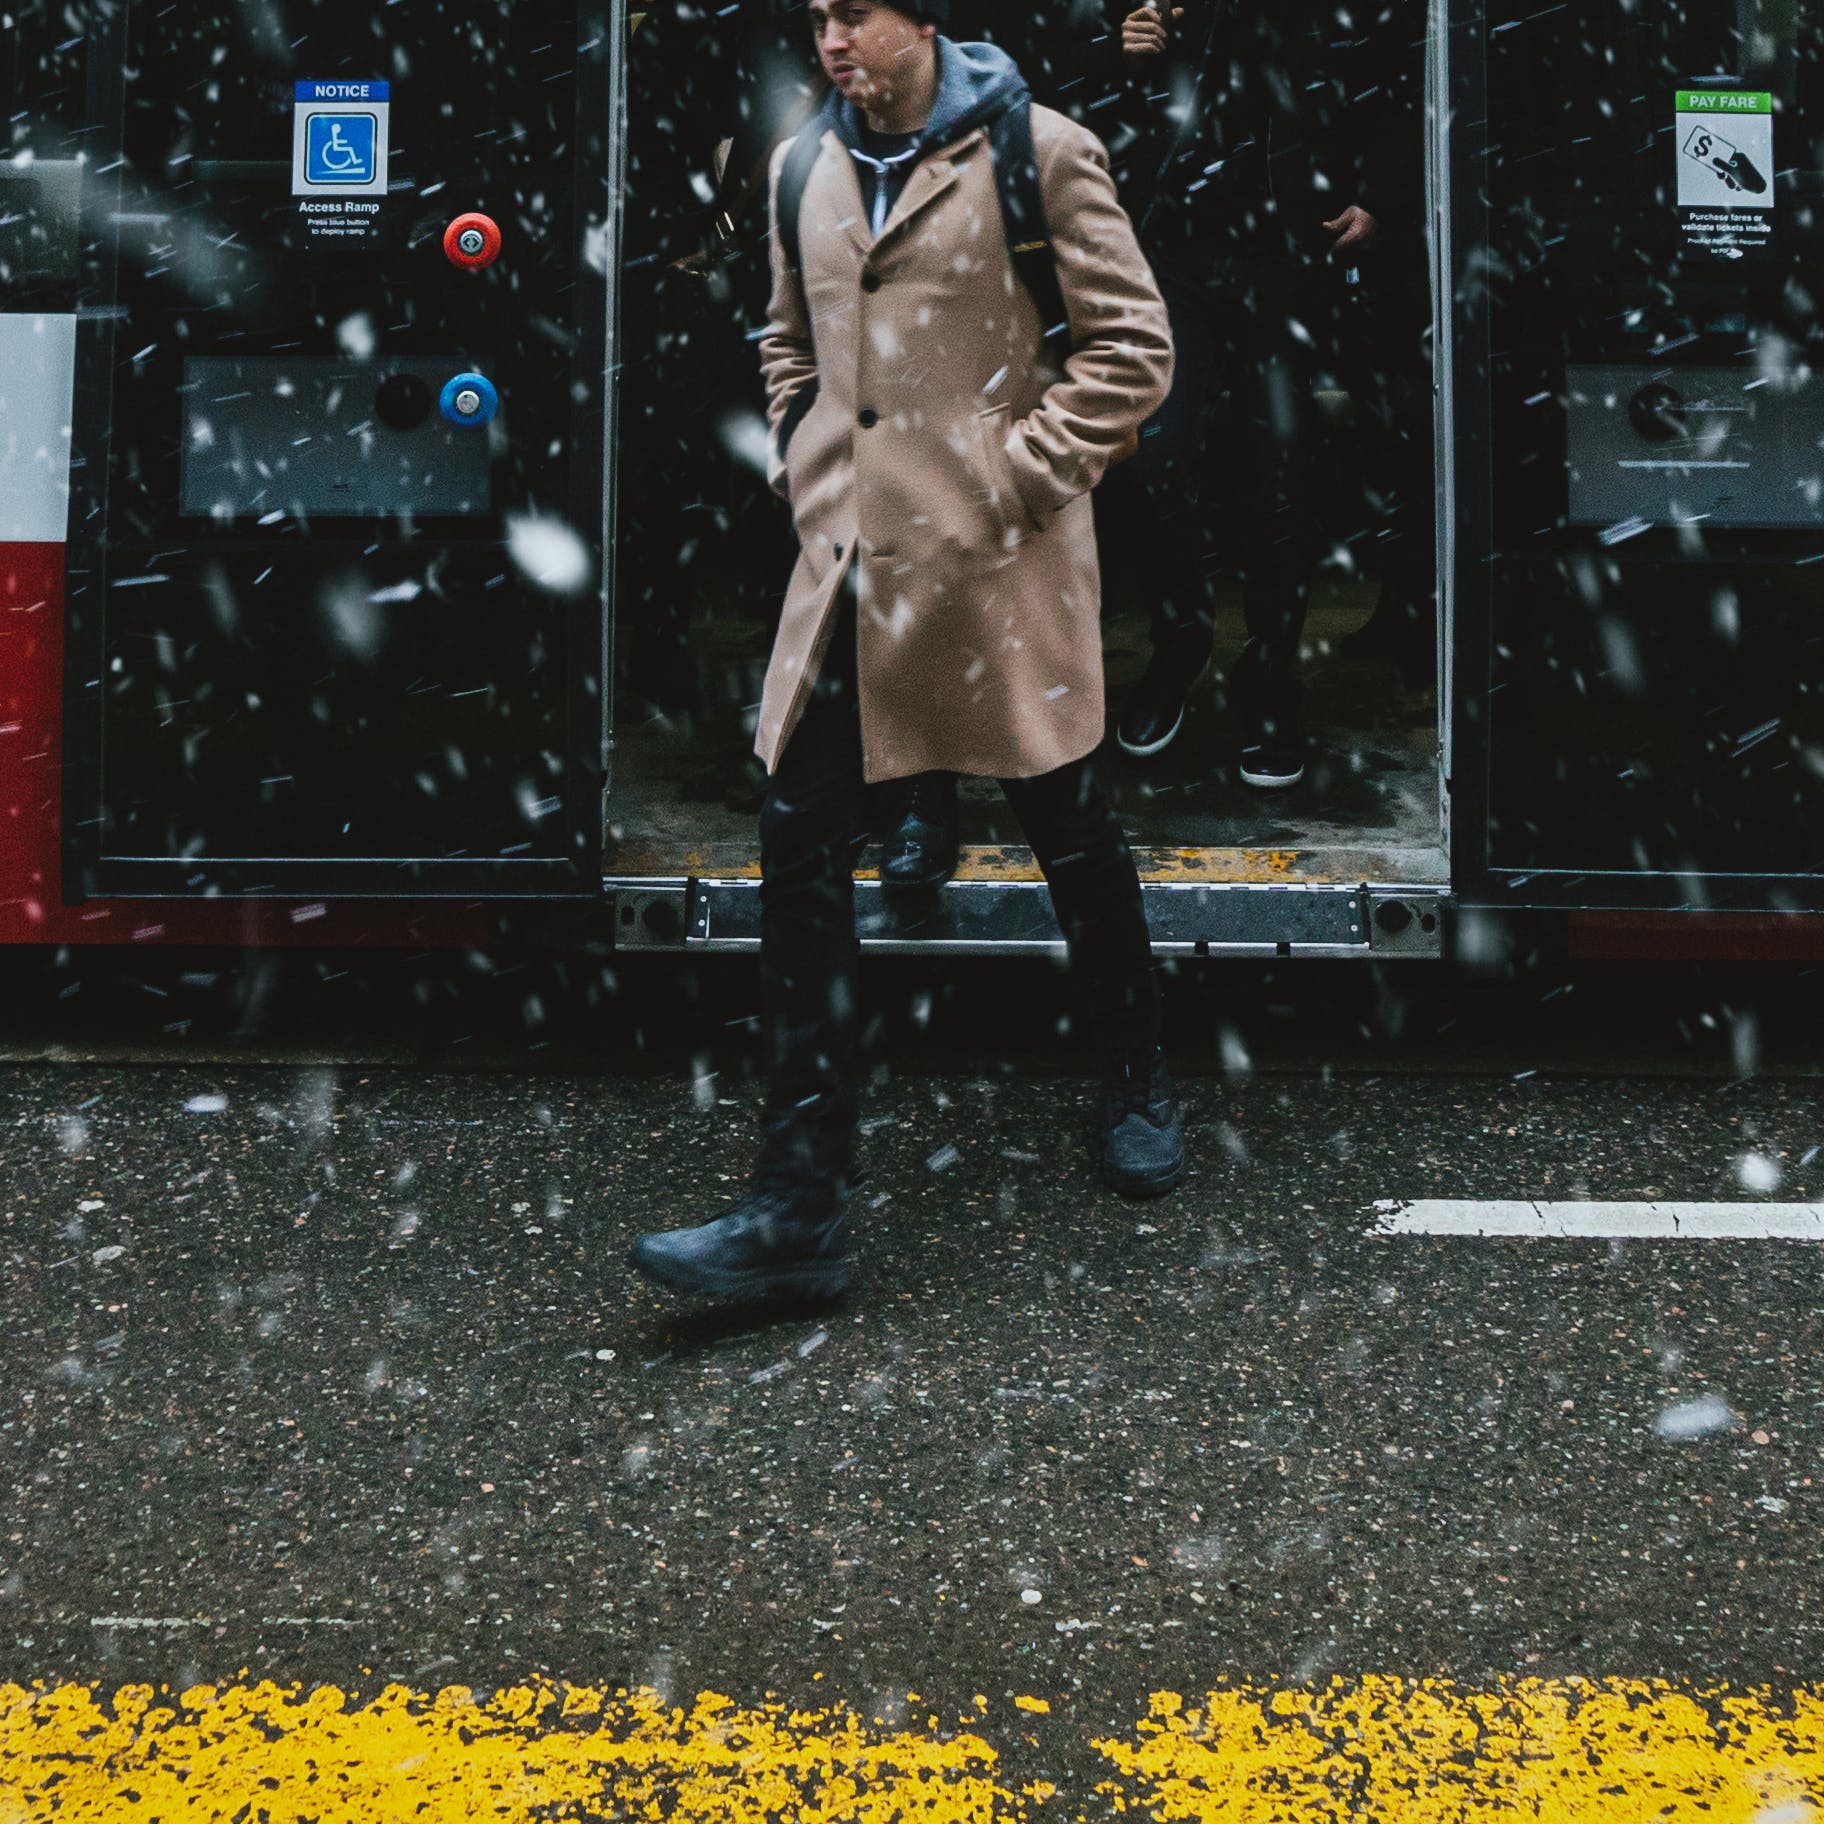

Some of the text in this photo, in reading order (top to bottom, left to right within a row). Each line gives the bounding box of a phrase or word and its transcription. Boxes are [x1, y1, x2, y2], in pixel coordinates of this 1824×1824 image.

[315, 84, 369, 98] NOTICE
[1689, 96, 1757, 108] PAY FARE
[299, 201, 380, 214] Access Ramp
[1689, 213, 1728, 221] Purchase
[1731, 213, 1752, 221] fares
[320, 228, 344, 236] deploy
[1681, 223, 1771, 232] validate tickets inside
